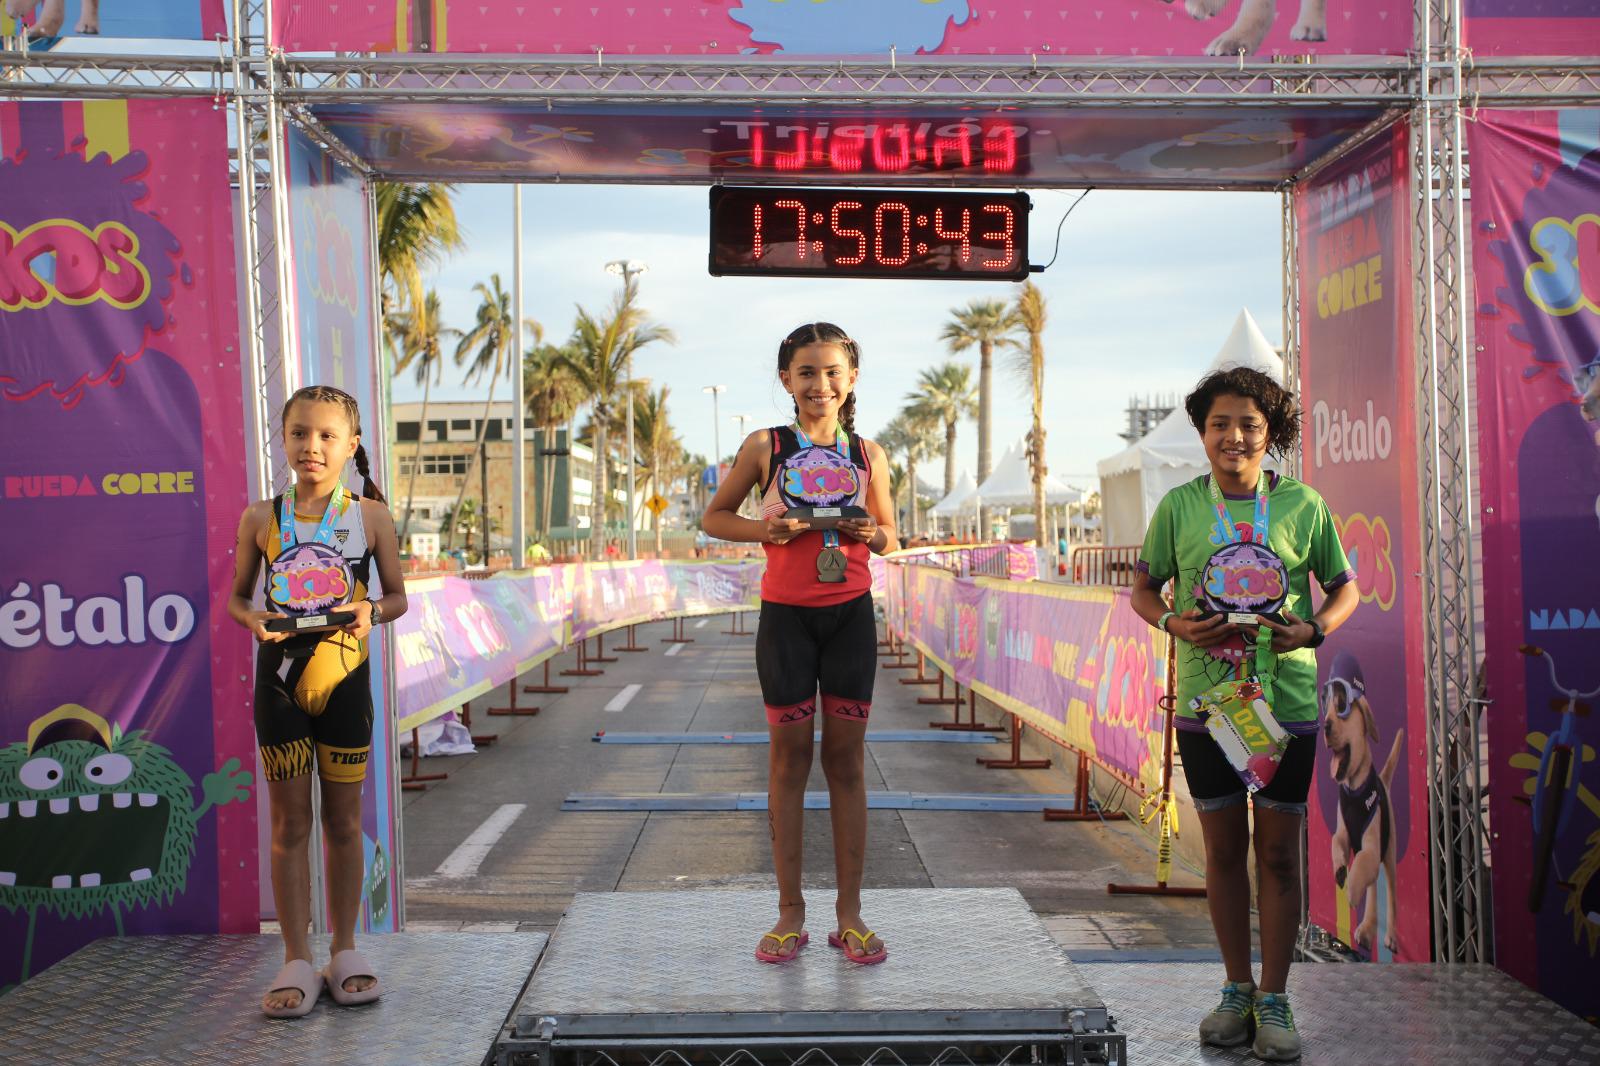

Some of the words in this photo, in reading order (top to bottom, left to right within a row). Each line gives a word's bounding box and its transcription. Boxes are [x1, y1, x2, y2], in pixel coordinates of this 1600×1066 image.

[754, 200, 1014, 268] 17:50:43
[1317, 254, 1382, 319] CORRE
[1312, 399, 1392, 468] Pétalo
[5, 473, 98, 498] RUEDA
[102, 471, 194, 495] CORRE
[1529, 607, 1600, 630] NADA
[1233, 708, 1270, 747] 047
[330, 751, 369, 765] TIGE
